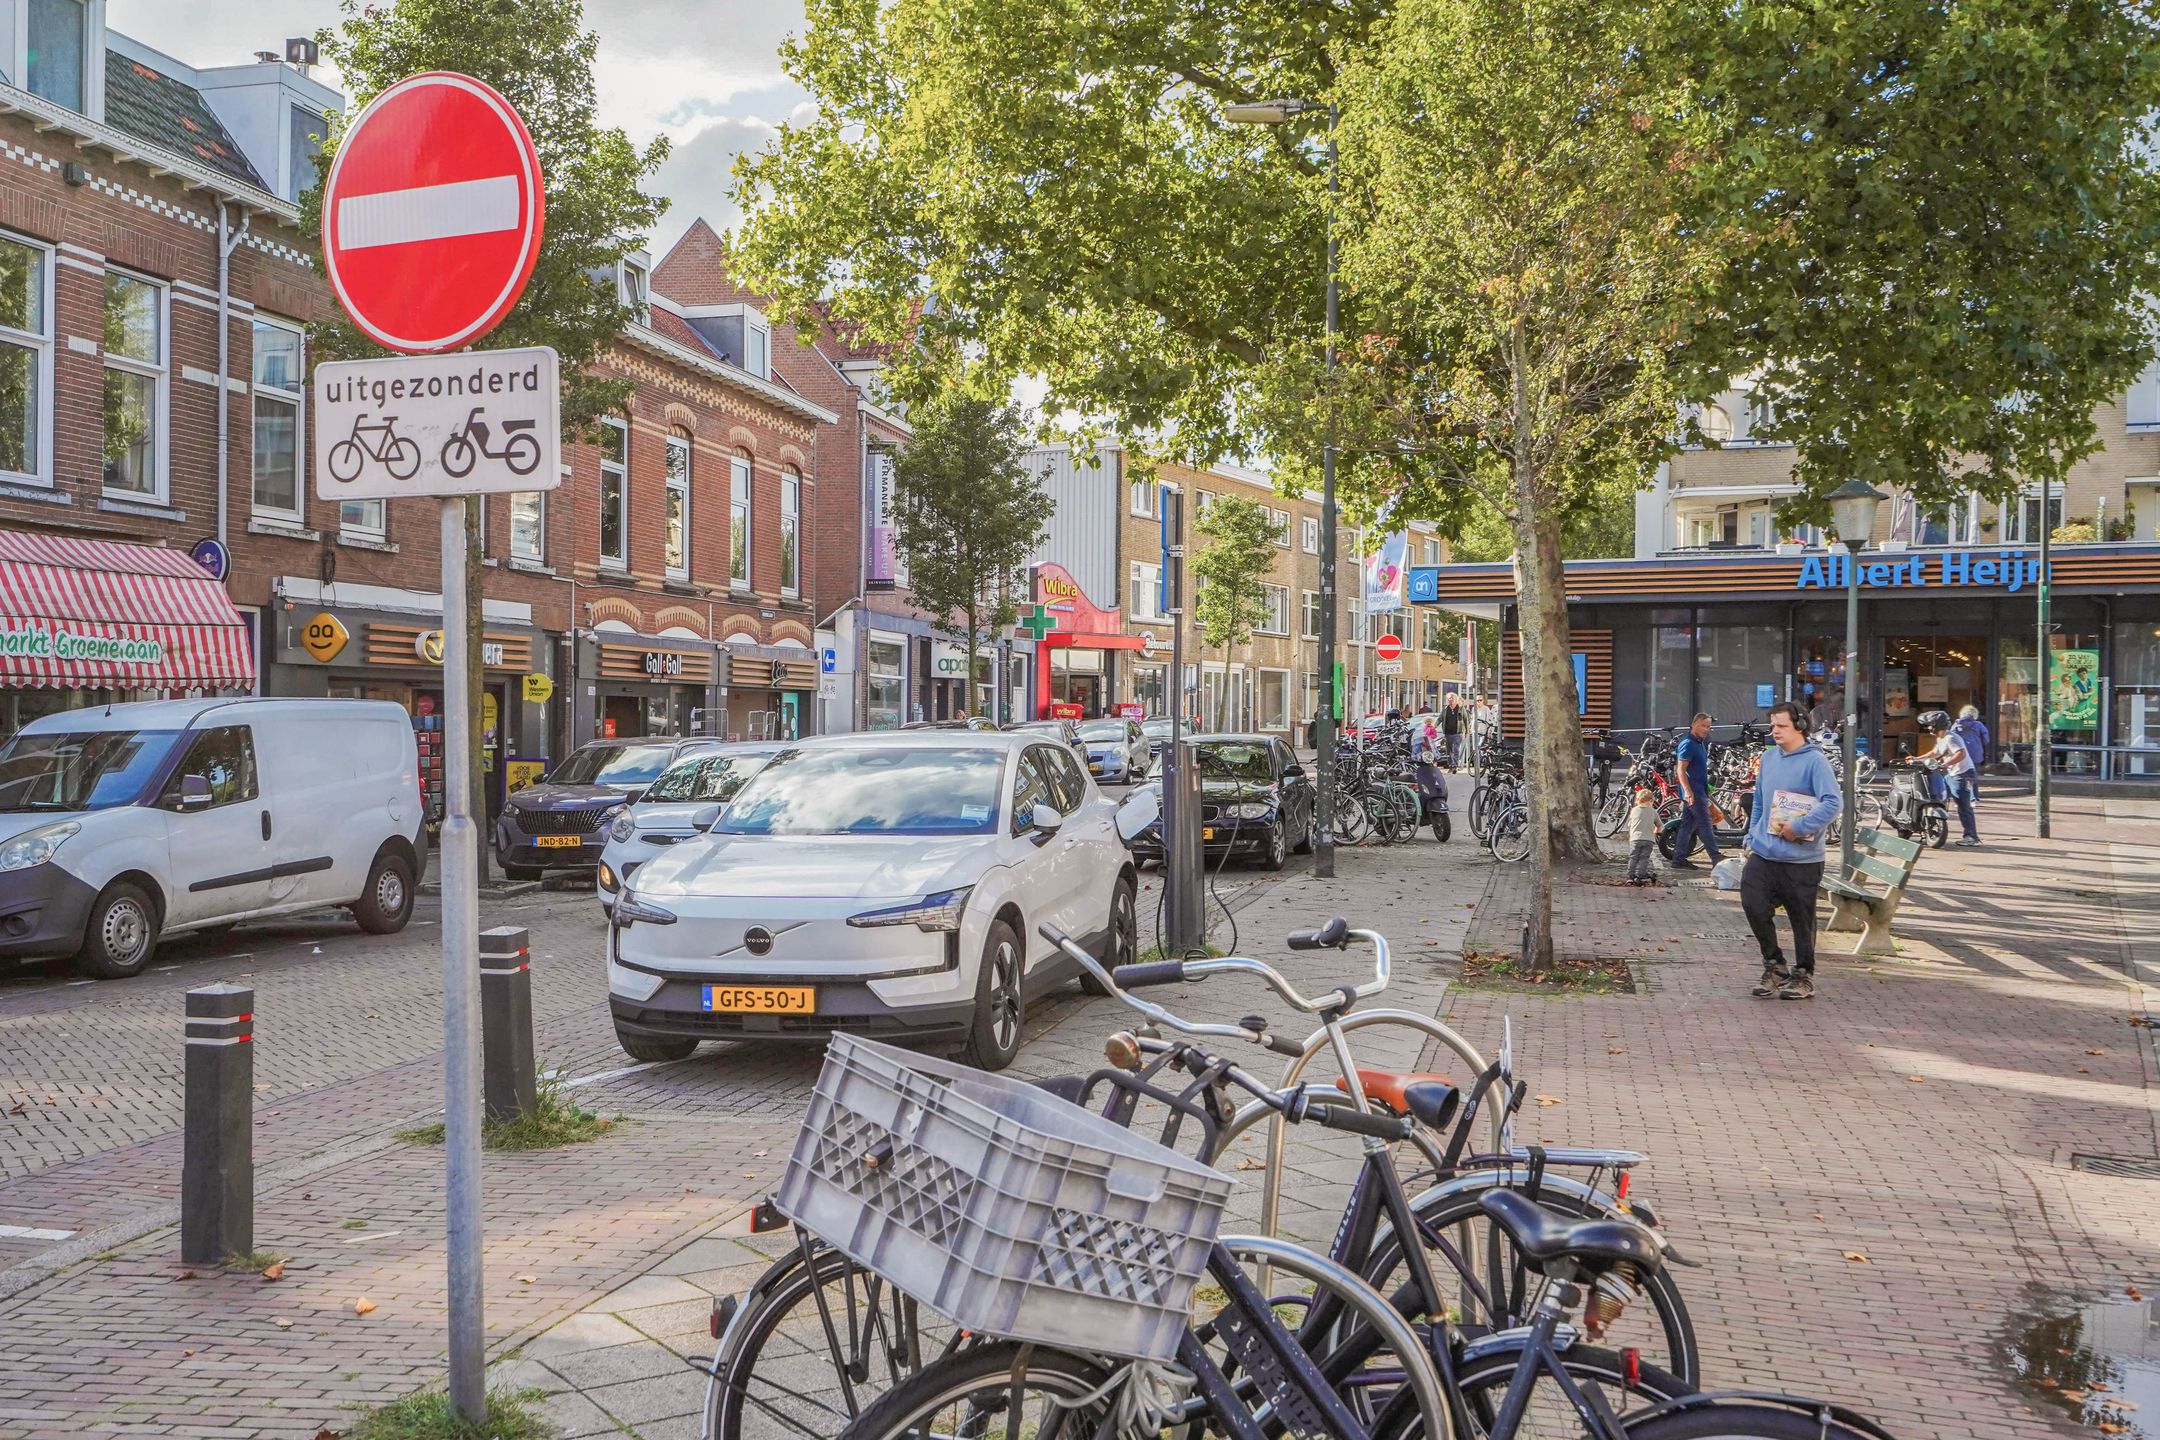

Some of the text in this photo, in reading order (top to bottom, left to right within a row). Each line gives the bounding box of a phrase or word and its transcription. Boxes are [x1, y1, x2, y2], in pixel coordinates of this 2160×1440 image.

[326, 364, 539, 408] uitgezonderd
[1796, 551, 2052, 592] Albert Heijn
[1044, 576, 1078, 597] Wibra
[0, 627, 159, 660] arkt Groeneaan
[646, 652, 662, 674] Gall
[666, 653, 682, 675] Gall
[539, 837, 578, 846] JND-82-N
[720, 990, 806, 1009] GFS-50-J
